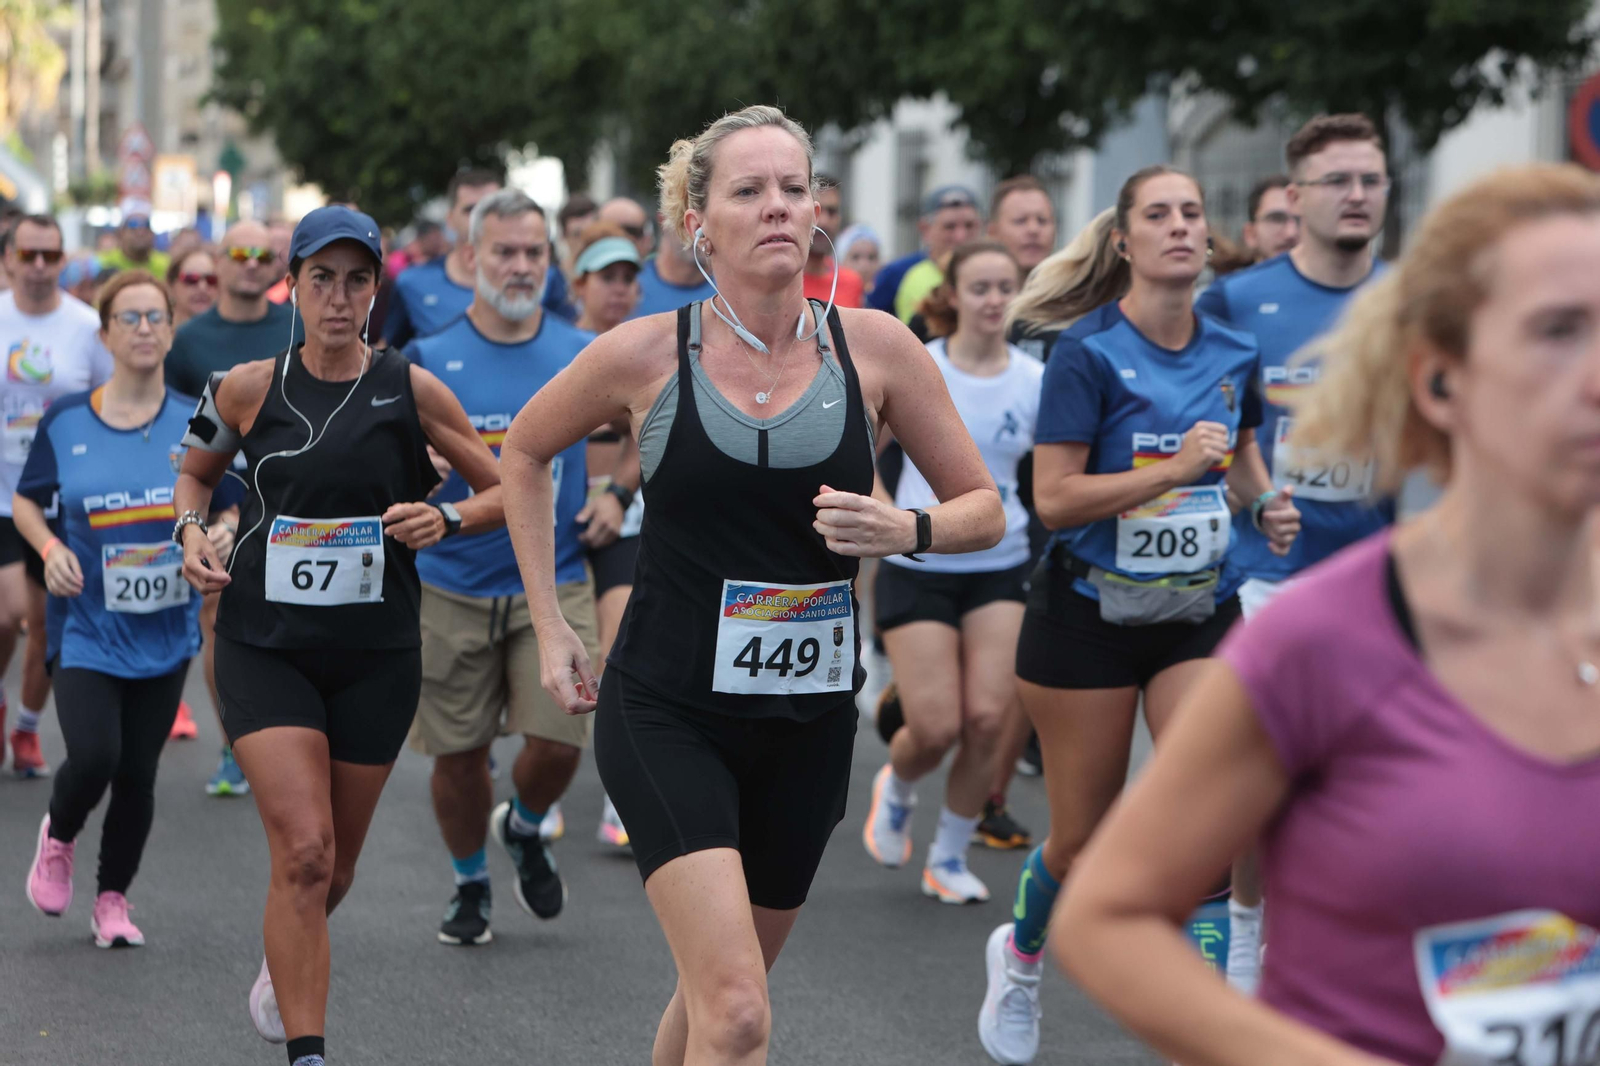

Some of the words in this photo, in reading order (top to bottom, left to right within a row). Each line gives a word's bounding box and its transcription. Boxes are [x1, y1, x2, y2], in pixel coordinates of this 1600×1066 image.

[278, 524, 326, 537] CARRERA
[329, 526, 373, 537] POPULAR
[328, 538, 354, 546] SANTO
[355, 536, 378, 545] ANGEL
[1131, 527, 1199, 558] 208
[291, 559, 339, 591] 67
[115, 576, 168, 601] 209
[736, 592, 799, 608] CARRERA
[803, 592, 844, 608] POPULAR
[732, 606, 797, 619] ASOCIACION
[800, 610, 825, 619] SANTO
[827, 605, 848, 616] ANGEL
[733, 636, 820, 678] 449
